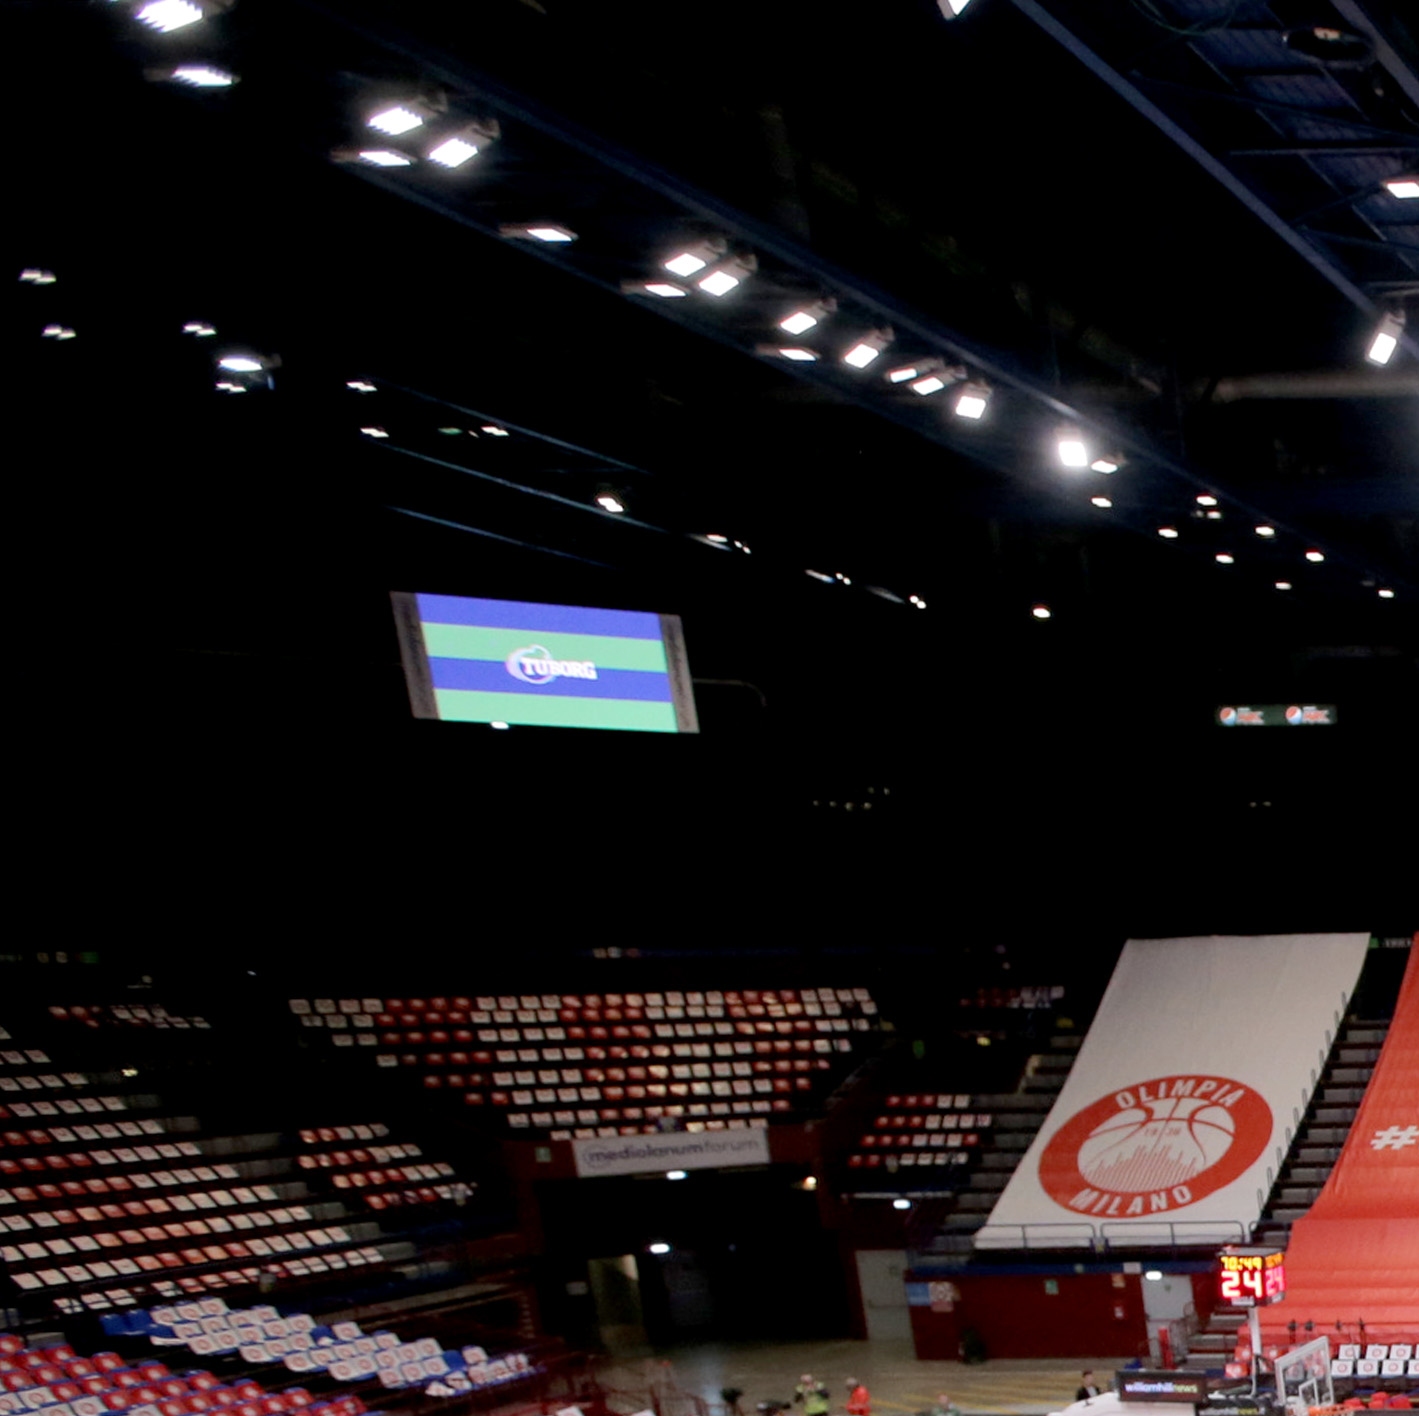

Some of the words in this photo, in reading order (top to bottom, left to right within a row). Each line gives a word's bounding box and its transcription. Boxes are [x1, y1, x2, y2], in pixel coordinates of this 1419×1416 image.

[519, 656, 599, 680] TUBORG
[1114, 1076, 1246, 1110] OLIMPIA
[1068, 1184, 1192, 1215] MILANO
[1221, 1270, 1263, 1298] 24
